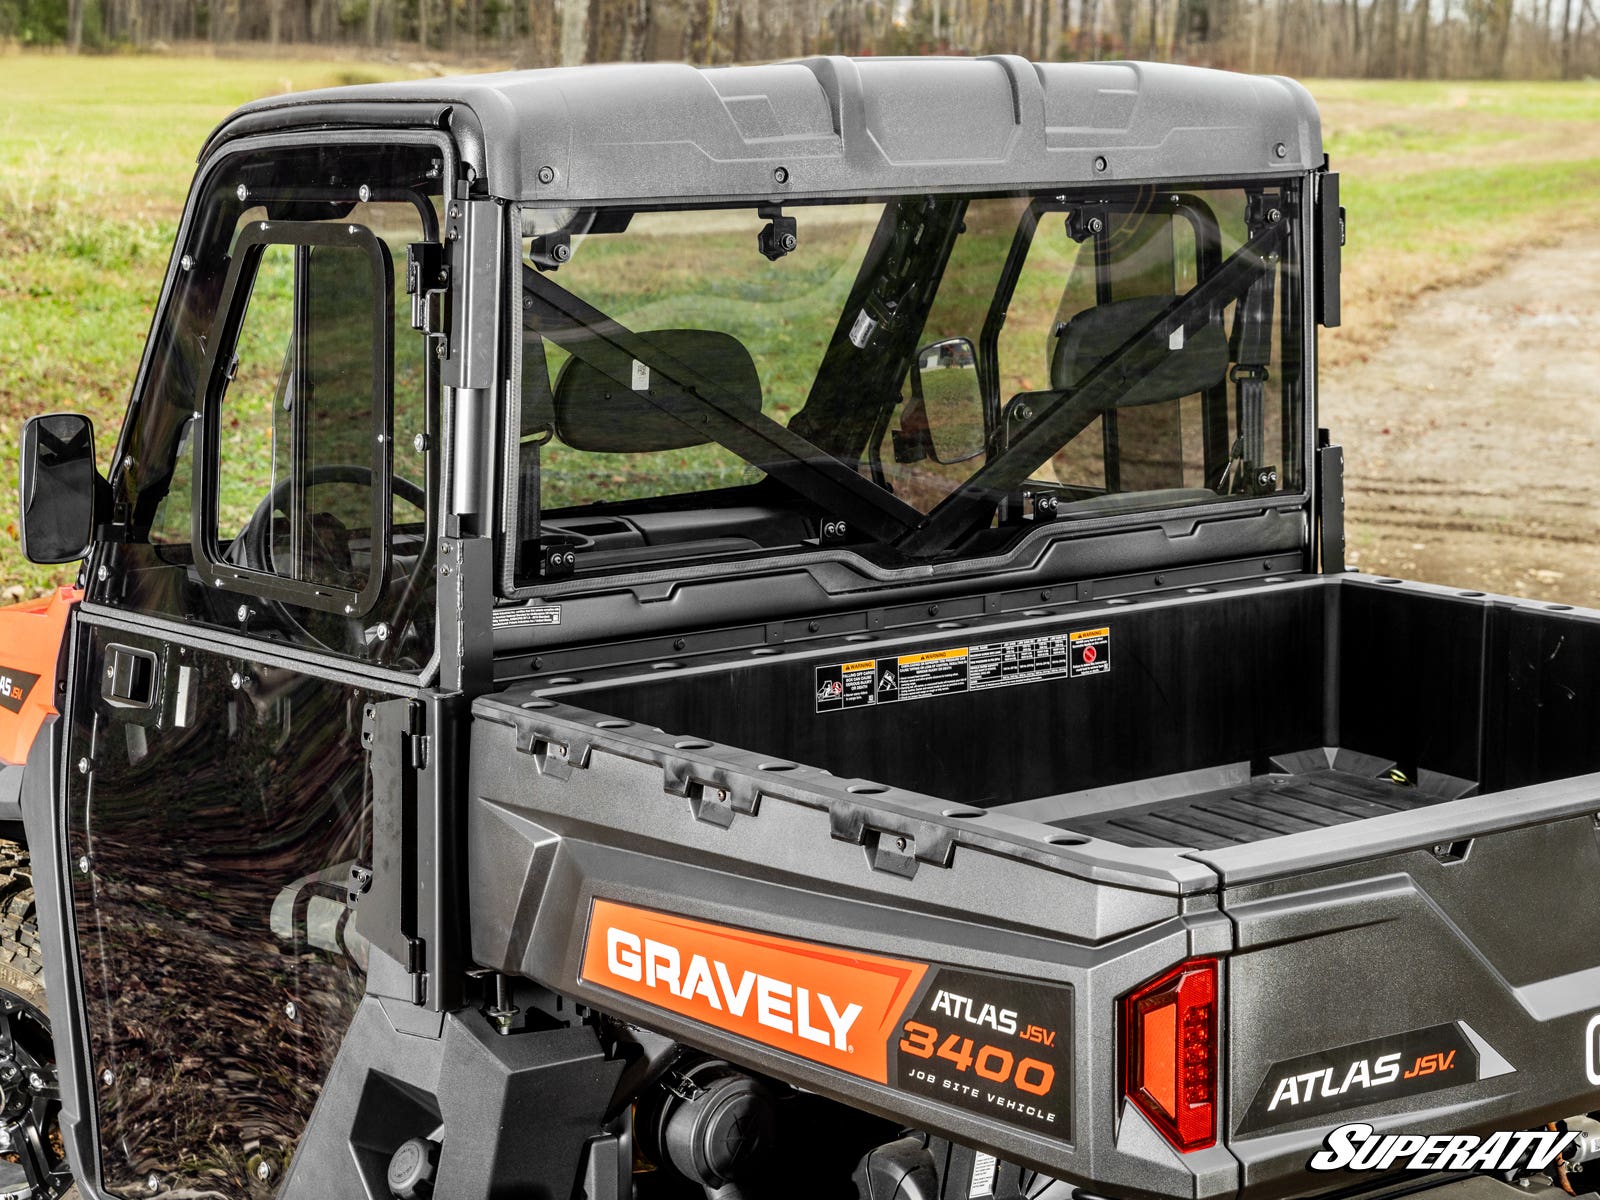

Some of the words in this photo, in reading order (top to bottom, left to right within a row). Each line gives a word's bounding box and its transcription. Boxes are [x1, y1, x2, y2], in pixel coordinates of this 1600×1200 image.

[607, 927, 863, 1052] GRAVELY
[931, 989, 1018, 1036] ATLAS
[900, 1020, 1056, 1096] 3400
[1267, 1052, 1401, 1112] ATLAS
[909, 1069, 936, 1084] JOB
[943, 1079, 980, 1098] SITE
[987, 1093, 1056, 1122] VEHICLE
